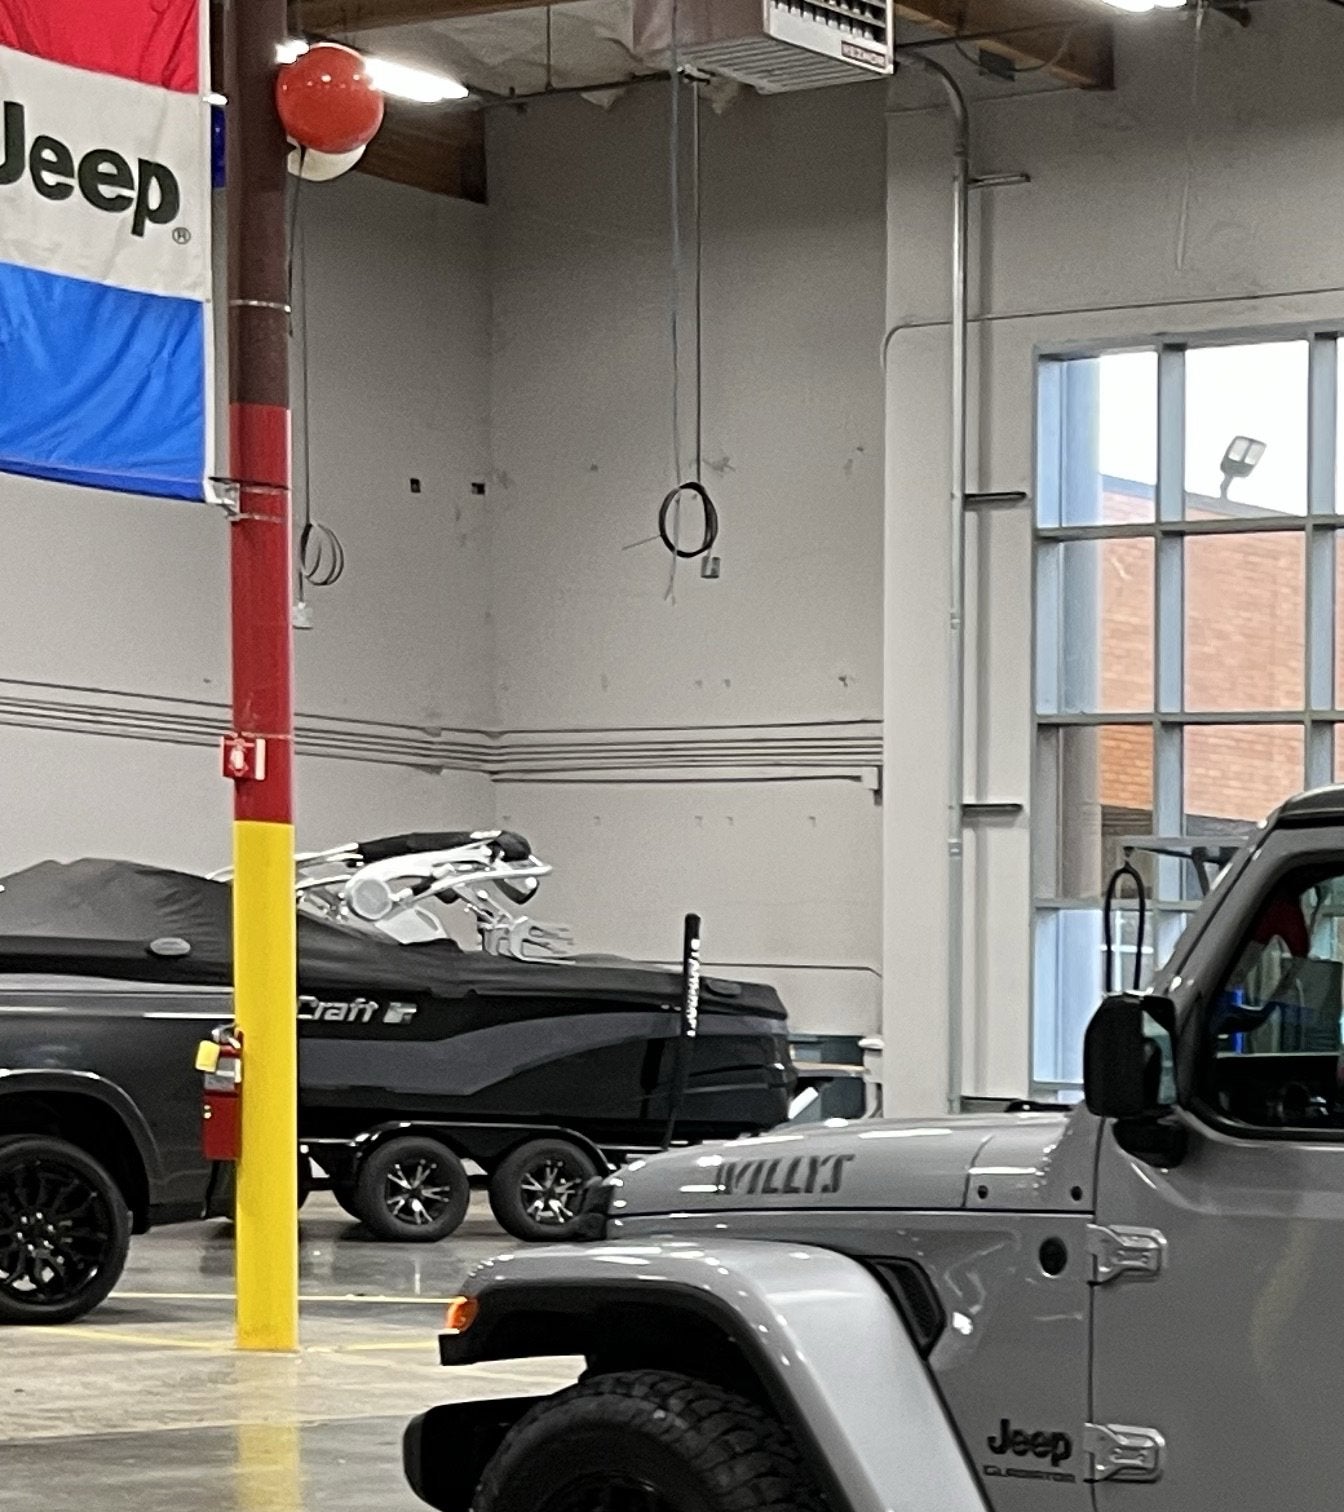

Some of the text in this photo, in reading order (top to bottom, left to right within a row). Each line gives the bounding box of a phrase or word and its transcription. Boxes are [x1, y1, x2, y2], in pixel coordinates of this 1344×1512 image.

[0, 101, 180, 237] Jeep
[715, 1154, 856, 1195] WILLYS
[987, 1418, 1072, 1467] Jeep
